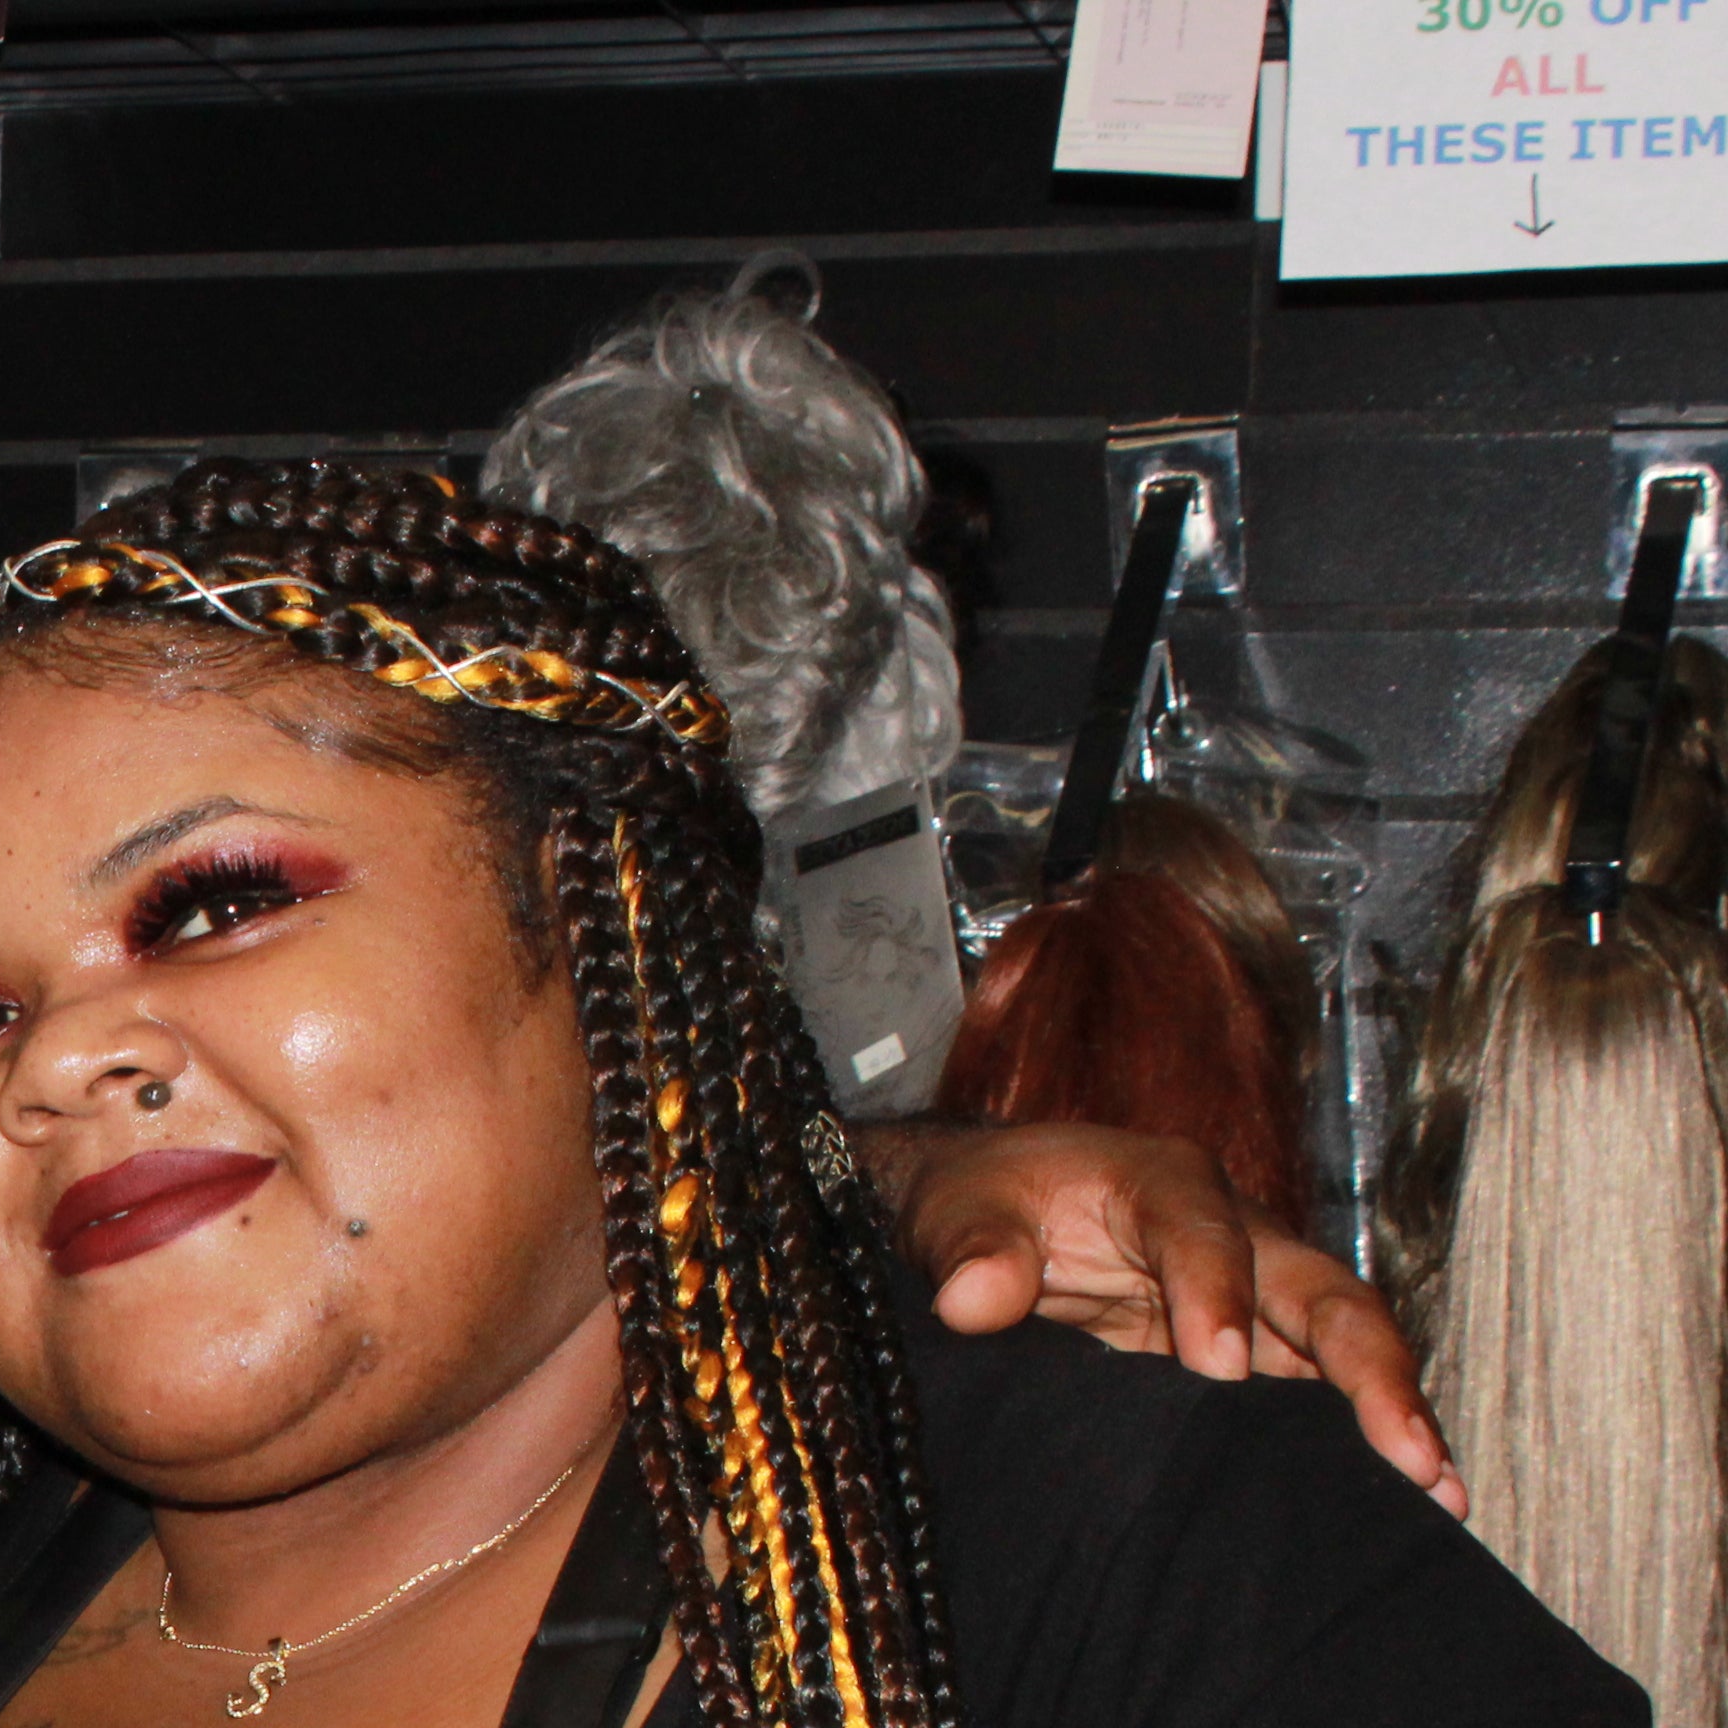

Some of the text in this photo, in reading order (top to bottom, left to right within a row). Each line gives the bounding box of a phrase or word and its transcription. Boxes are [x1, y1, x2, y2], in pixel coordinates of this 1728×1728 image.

[1415, 0, 1708, 33] 30% OFF
[1490, 53, 1606, 98] ALL
[1345, 120, 1546, 168] THESE
